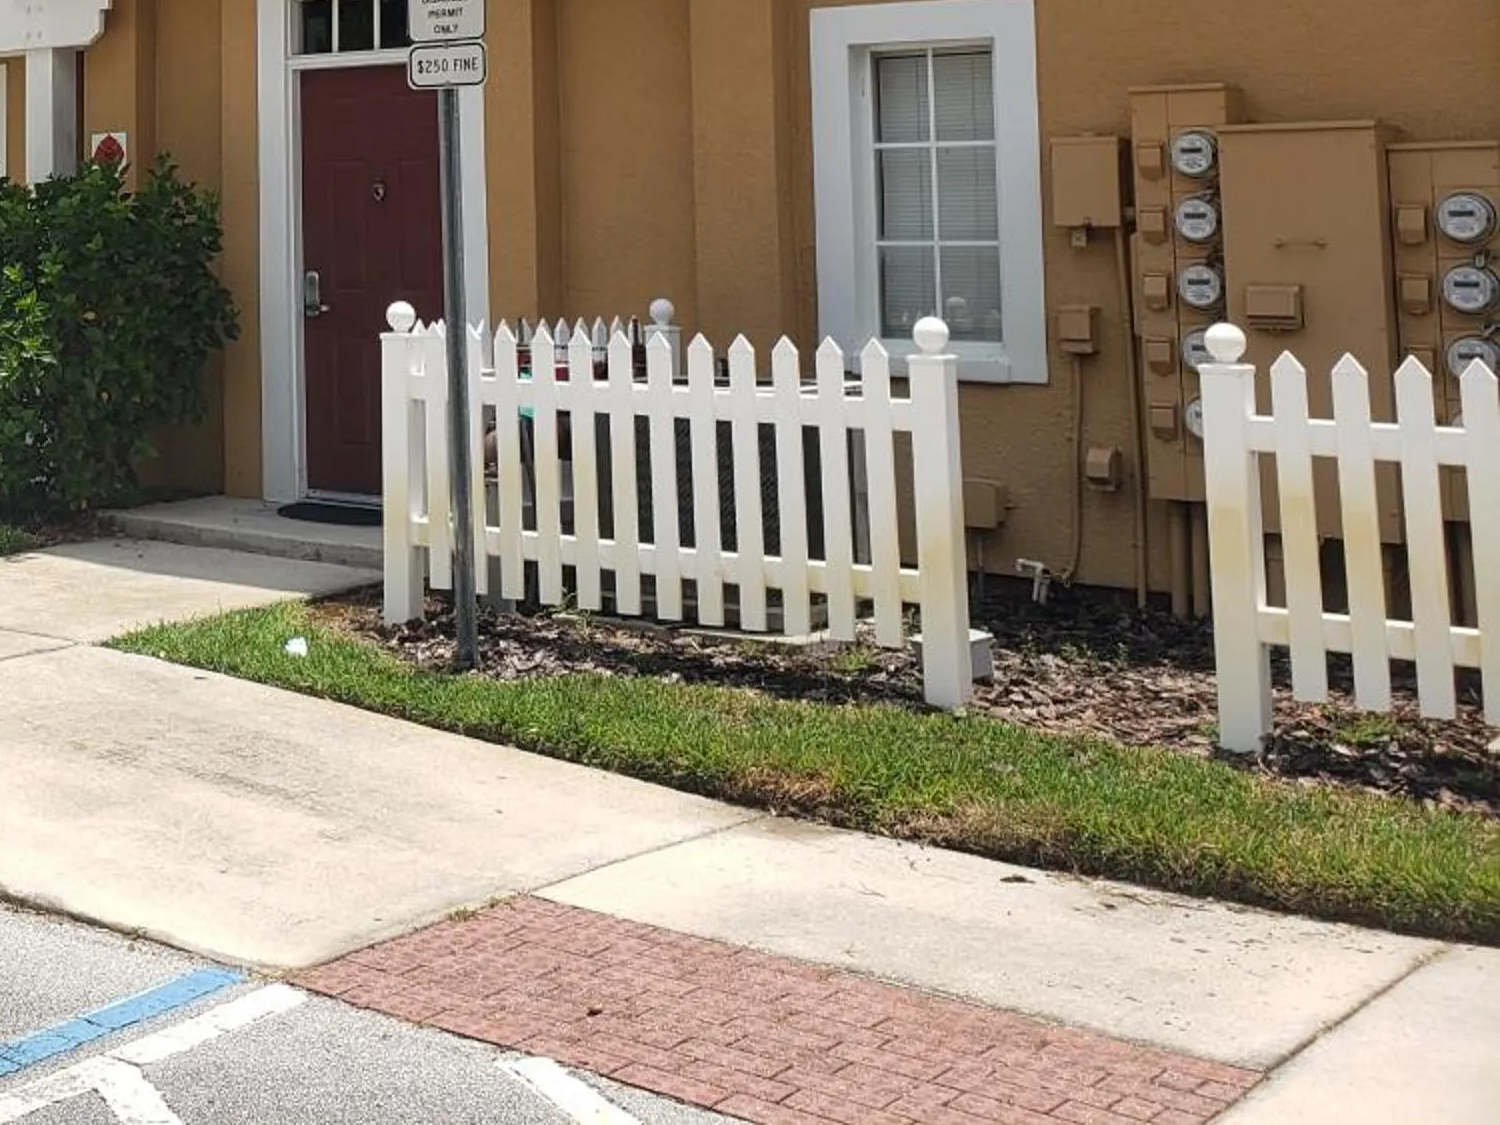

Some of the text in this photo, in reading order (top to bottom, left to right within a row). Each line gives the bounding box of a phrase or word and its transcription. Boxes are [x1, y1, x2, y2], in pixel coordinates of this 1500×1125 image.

[427, 7, 463, 20] PERMIT
[433, 24, 459, 35] ONLY
[417, 56, 479, 74] $250 FINE
